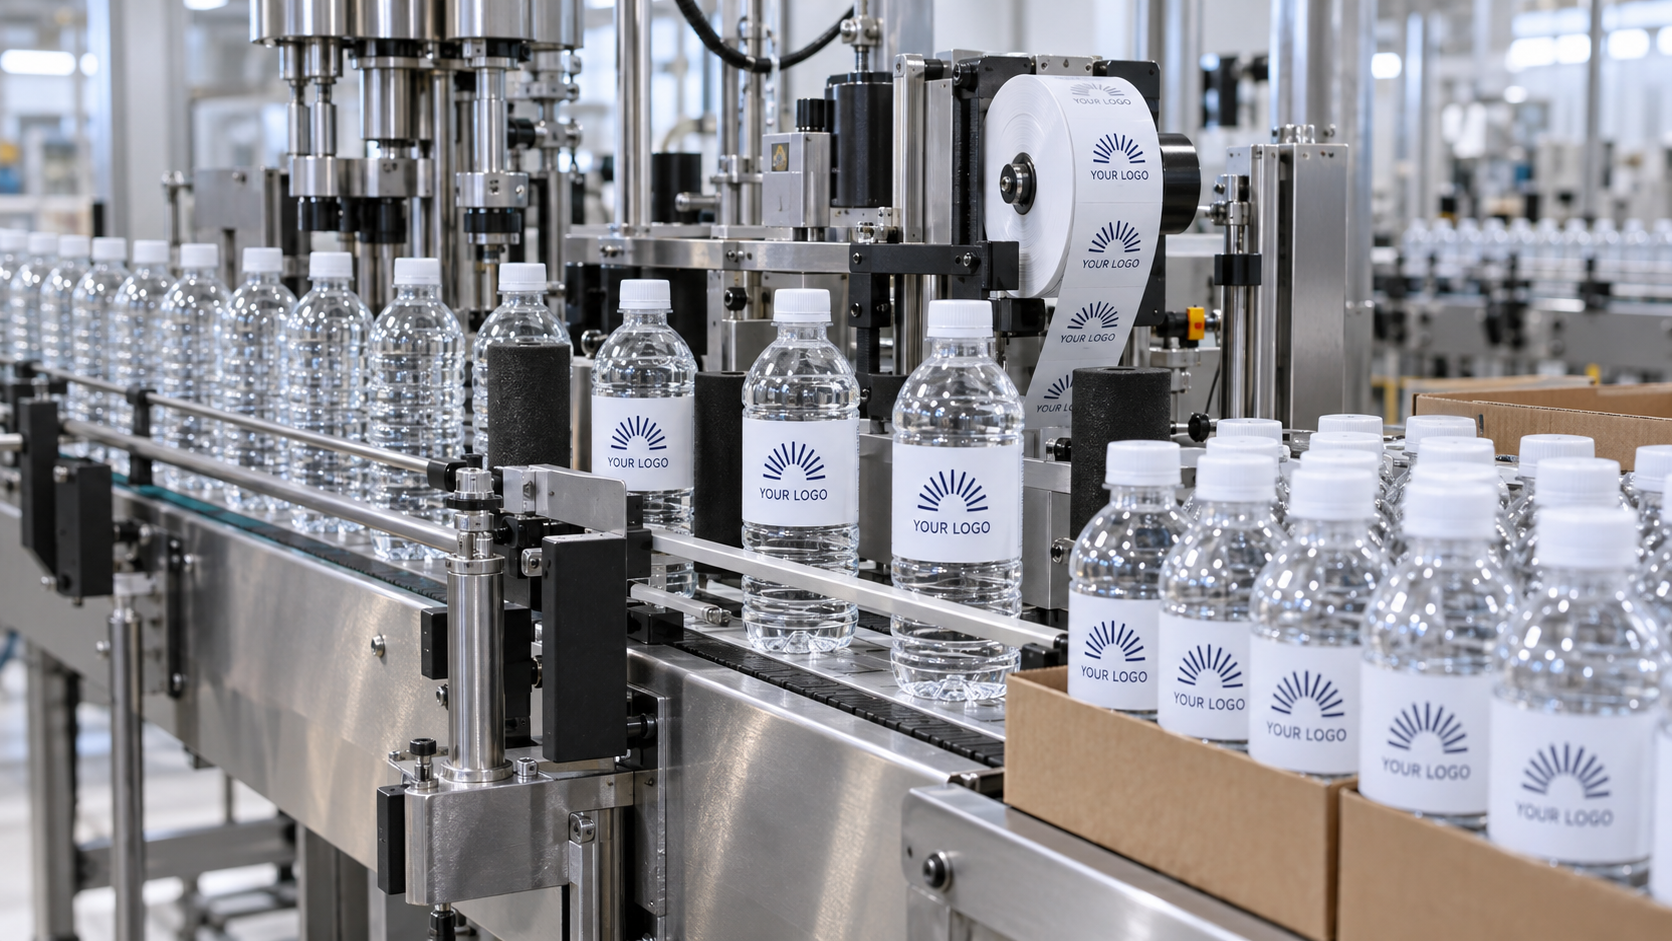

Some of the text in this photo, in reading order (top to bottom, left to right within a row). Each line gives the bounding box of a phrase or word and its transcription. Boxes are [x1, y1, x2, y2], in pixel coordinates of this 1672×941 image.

[1091, 170, 1149, 180] YOUR LOGO
[1082, 258, 1140, 269] YOUR LOGO
[1061, 333, 1115, 343] YOUR LOGO
[1036, 403, 1062, 413] YOUR
[607, 456, 669, 469] YOUR LOGO
[759, 487, 828, 502] YOUR LOGO
[913, 519, 991, 535] YOUR LOGO
[1081, 665, 1148, 684] YOUR LOGO
[1174, 692, 1246, 712] YOUR LOGO
[1266, 720, 1348, 743] YOUR LOGO
[1383, 757, 1471, 781] YOUR LOGO
[1517, 802, 1615, 828] YOUR LOGO
